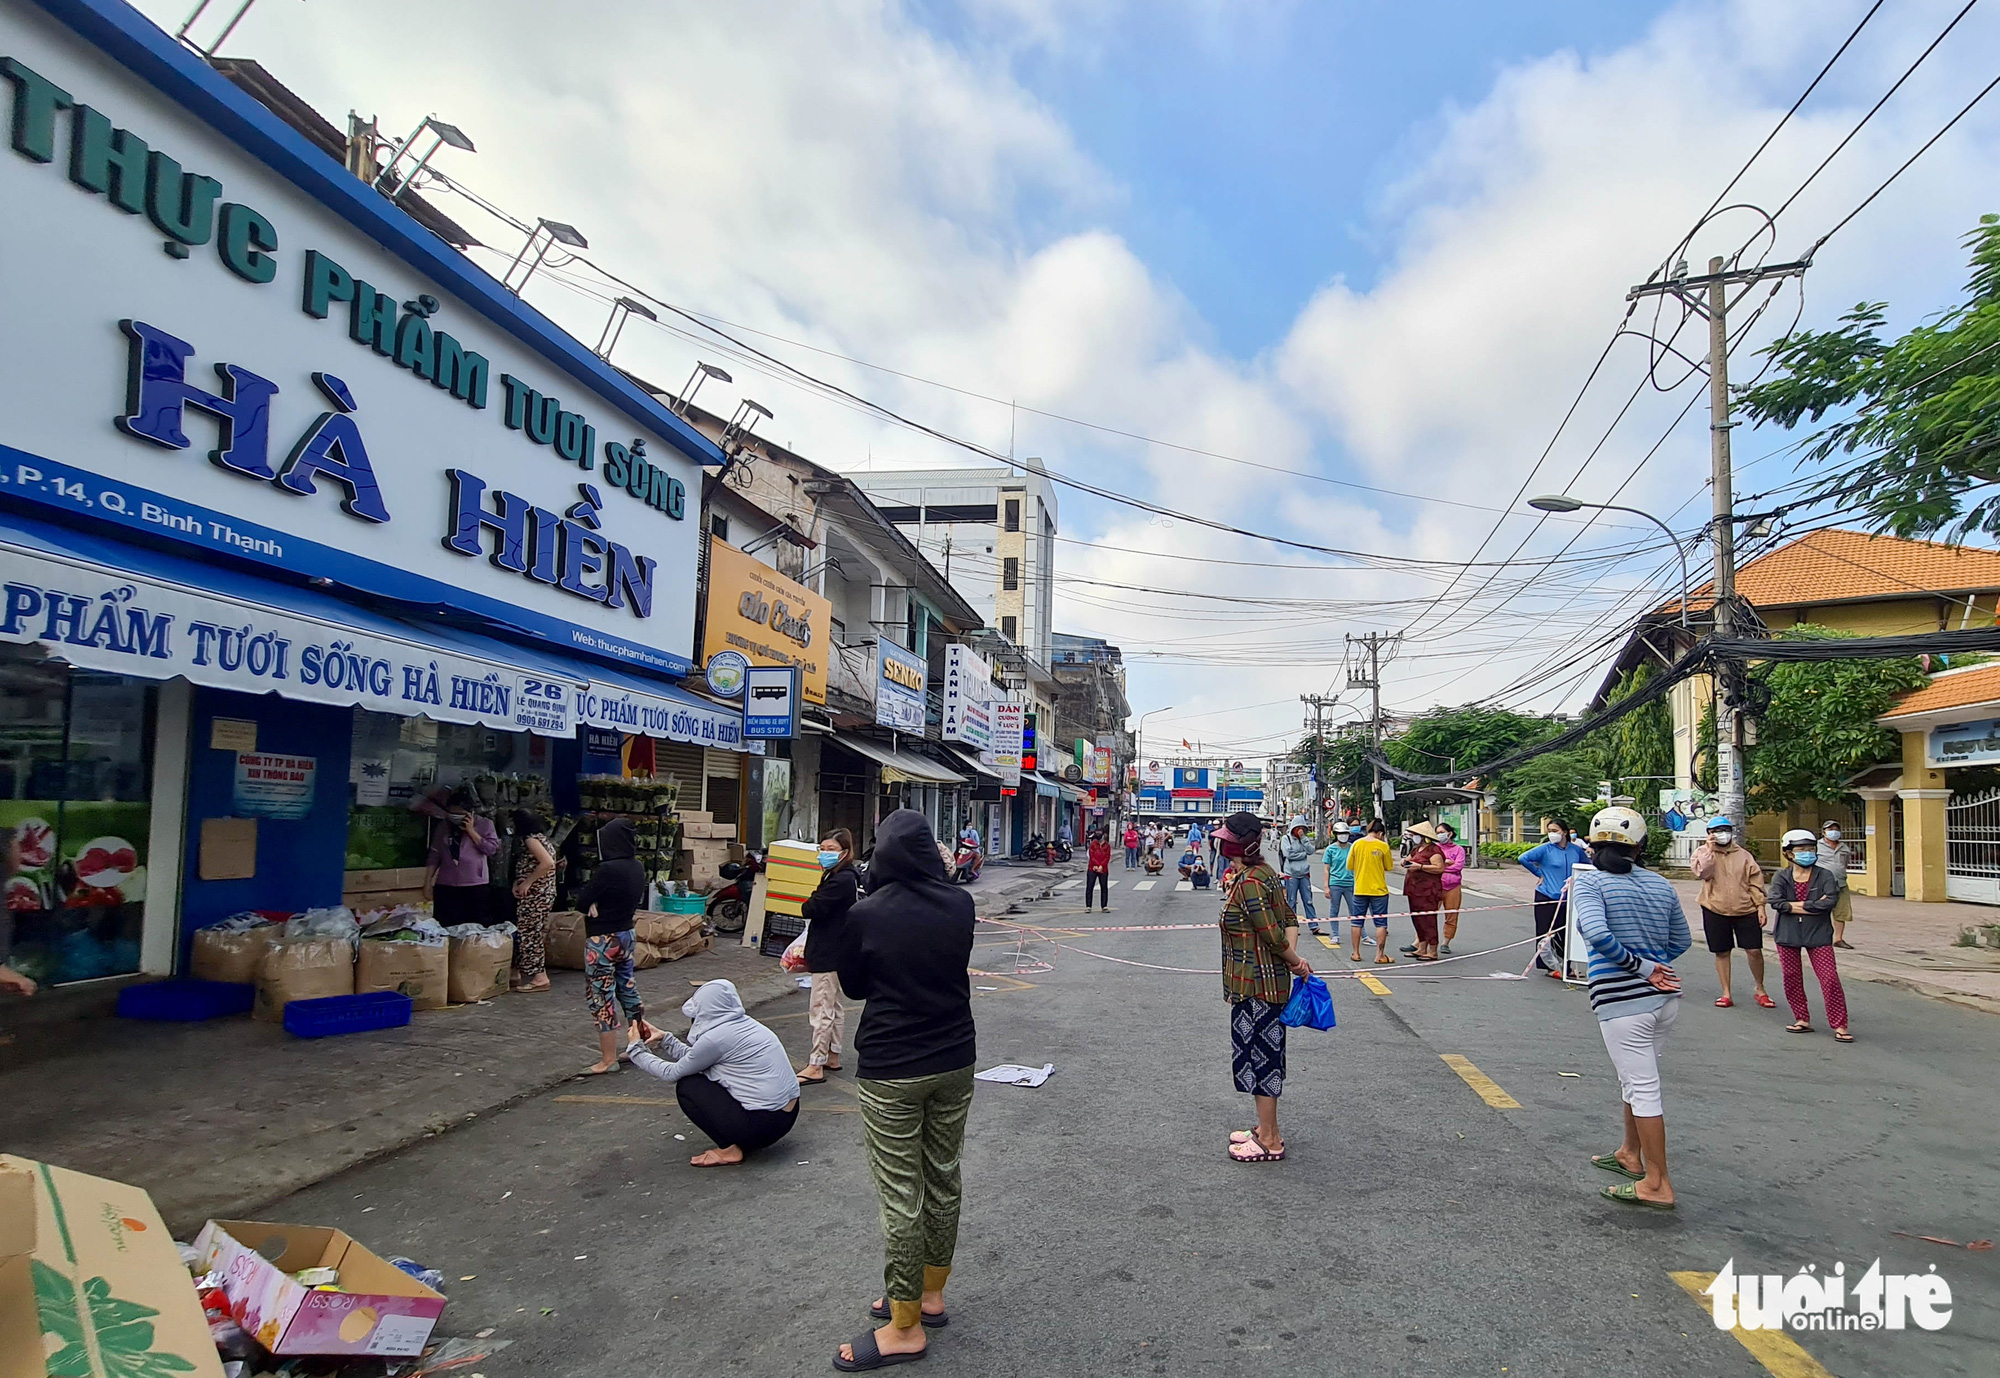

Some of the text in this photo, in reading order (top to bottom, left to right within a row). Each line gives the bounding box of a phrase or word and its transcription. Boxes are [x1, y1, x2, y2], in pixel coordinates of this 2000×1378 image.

[0, 56, 686, 521] THỰC PHẨM TƯƠI SỐNG
[113, 318, 658, 618] HÀ HIỀN
[17, 464, 94, 508] P.14,
[100, 491, 135, 518] Q.
[141, 501, 203, 536] Bình
[208, 521, 283, 559] Thạnh
[0, 581, 512, 717] PHẨM TƯƠI SỐNG HÀ HIỀN
[524, 680, 562, 700] 26
[883, 656, 923, 692] SENKO
[946, 647, 959, 734] THANH TÂM
[528, 698, 550, 710] QUANG
[997, 704, 1020, 713] DÁN
[516, 713, 564, 730] 0909 691 294
[641, 704, 669, 731] TƯƠI
[671, 709, 699, 737] SỐNG
[701, 716, 715, 740] HÀ
[718, 720, 740, 744] HIỀN
[239, 753, 261, 766] CÔNG
[264, 756, 273, 766] TY
[275, 757, 283, 767] TP
[230, 1253, 260, 1286] ROSSI
[309, 1294, 356, 1310] ROSSI
